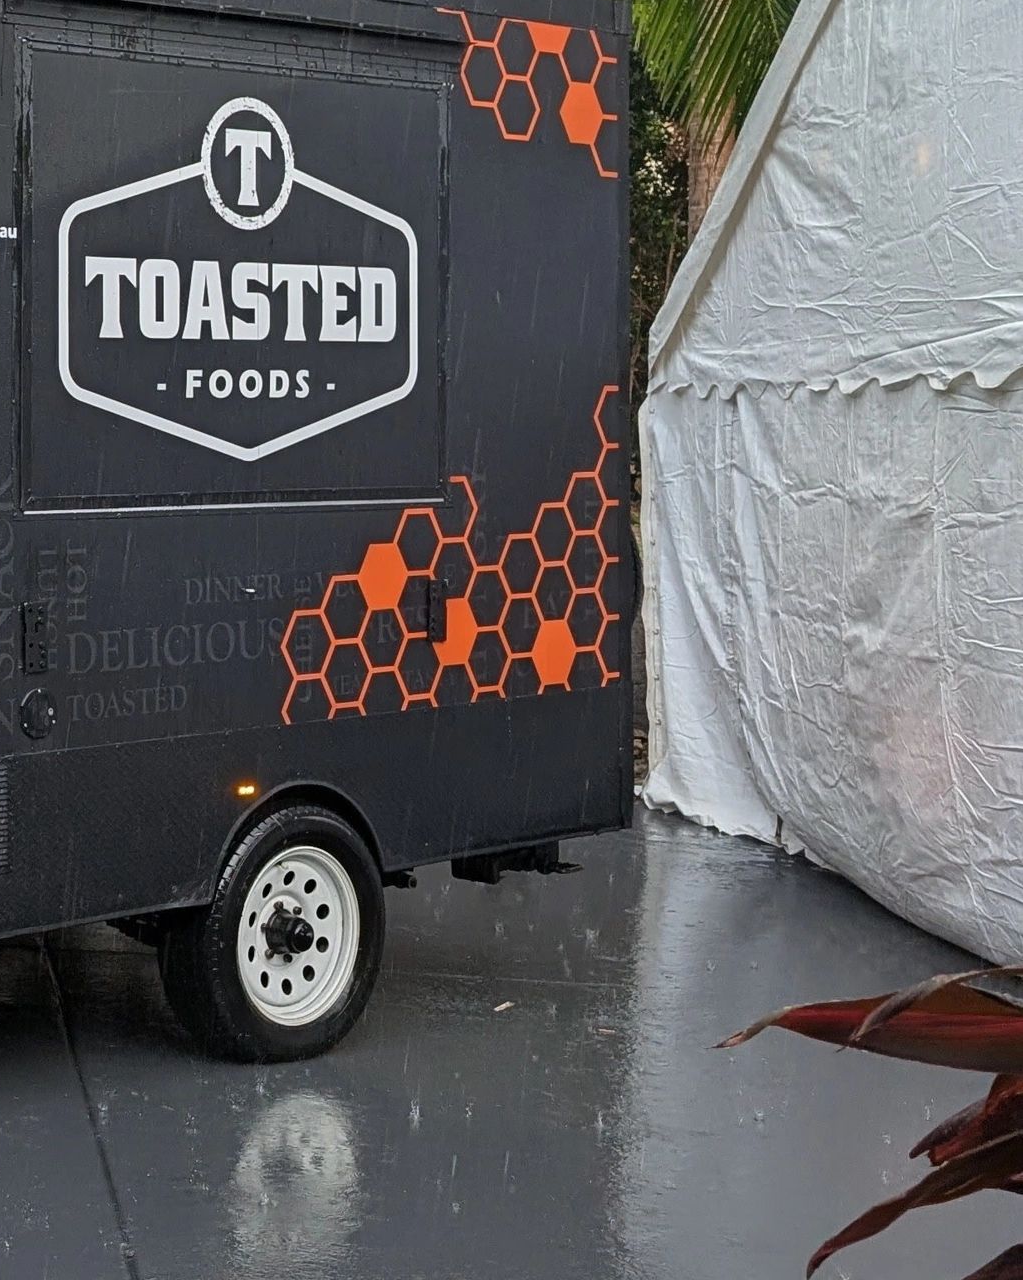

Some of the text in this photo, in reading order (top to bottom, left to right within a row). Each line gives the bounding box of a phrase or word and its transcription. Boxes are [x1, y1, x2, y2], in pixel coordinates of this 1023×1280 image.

[224, 128, 272, 207] T
[84, 255, 398, 343] TOASTED
[184, 368, 311, 399] FOODS
[184, 572, 283, 606] DINNER
[65, 616, 286, 675] DELICIOUS
[65, 683, 189, 723] TOASTED
